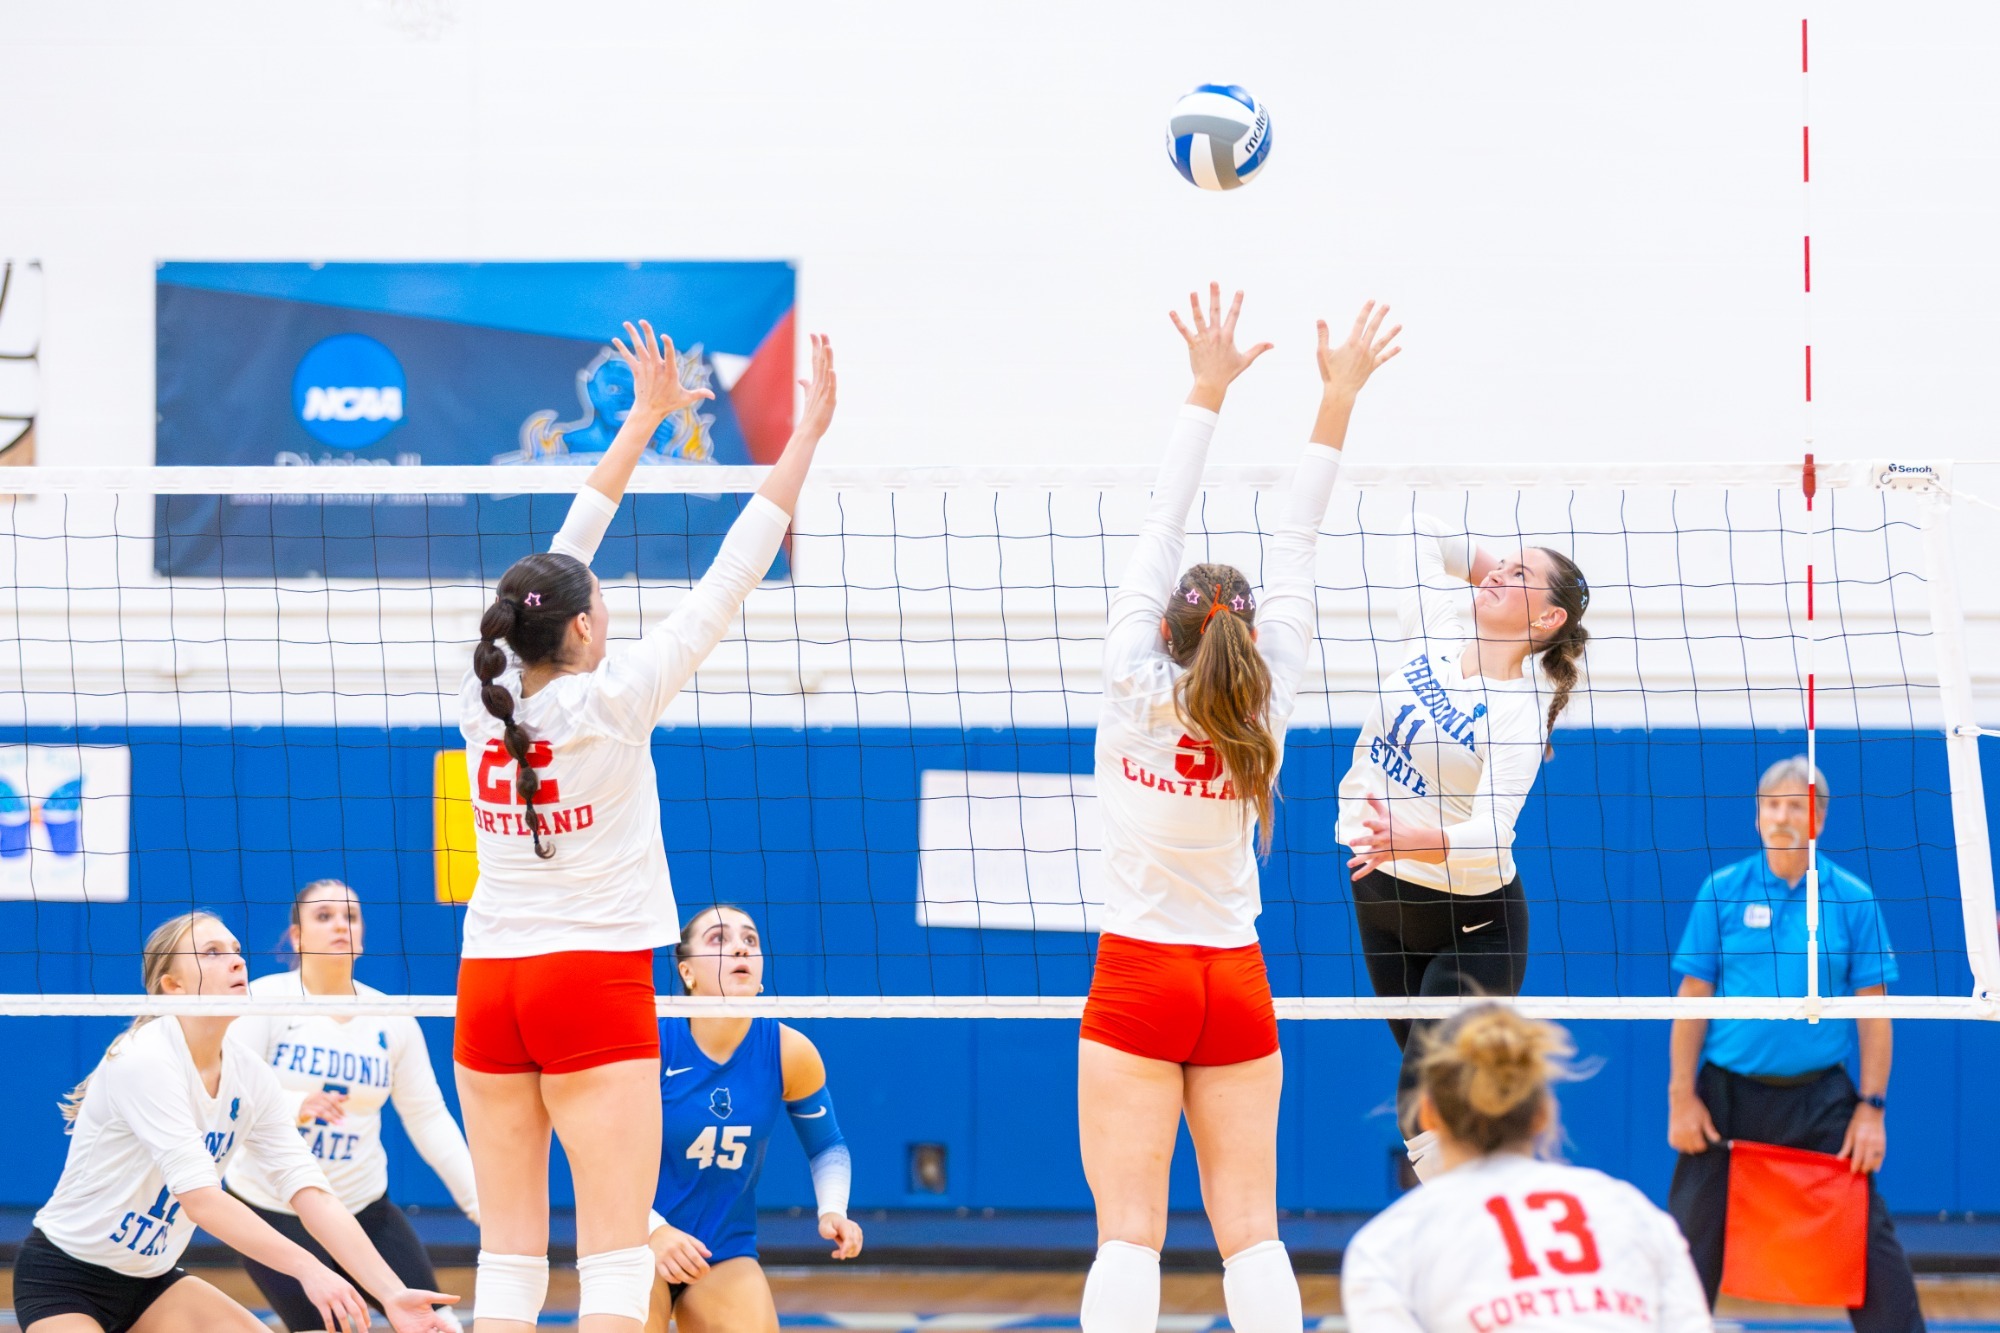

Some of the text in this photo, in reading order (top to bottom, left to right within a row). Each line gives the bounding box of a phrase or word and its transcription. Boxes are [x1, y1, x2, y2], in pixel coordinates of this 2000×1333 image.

[1898, 465, 1933, 473] Senoh
[1386, 703, 1426, 762] 11
[477, 738, 560, 805] 22
[1370, 735, 1430, 797] STATE
[471, 804, 594, 836] ORTLAND
[297, 1126, 360, 1161] TATE
[685, 1125, 752, 1171] 45
[109, 1211, 168, 1257] STA
[1485, 1190, 1603, 1281] 13
